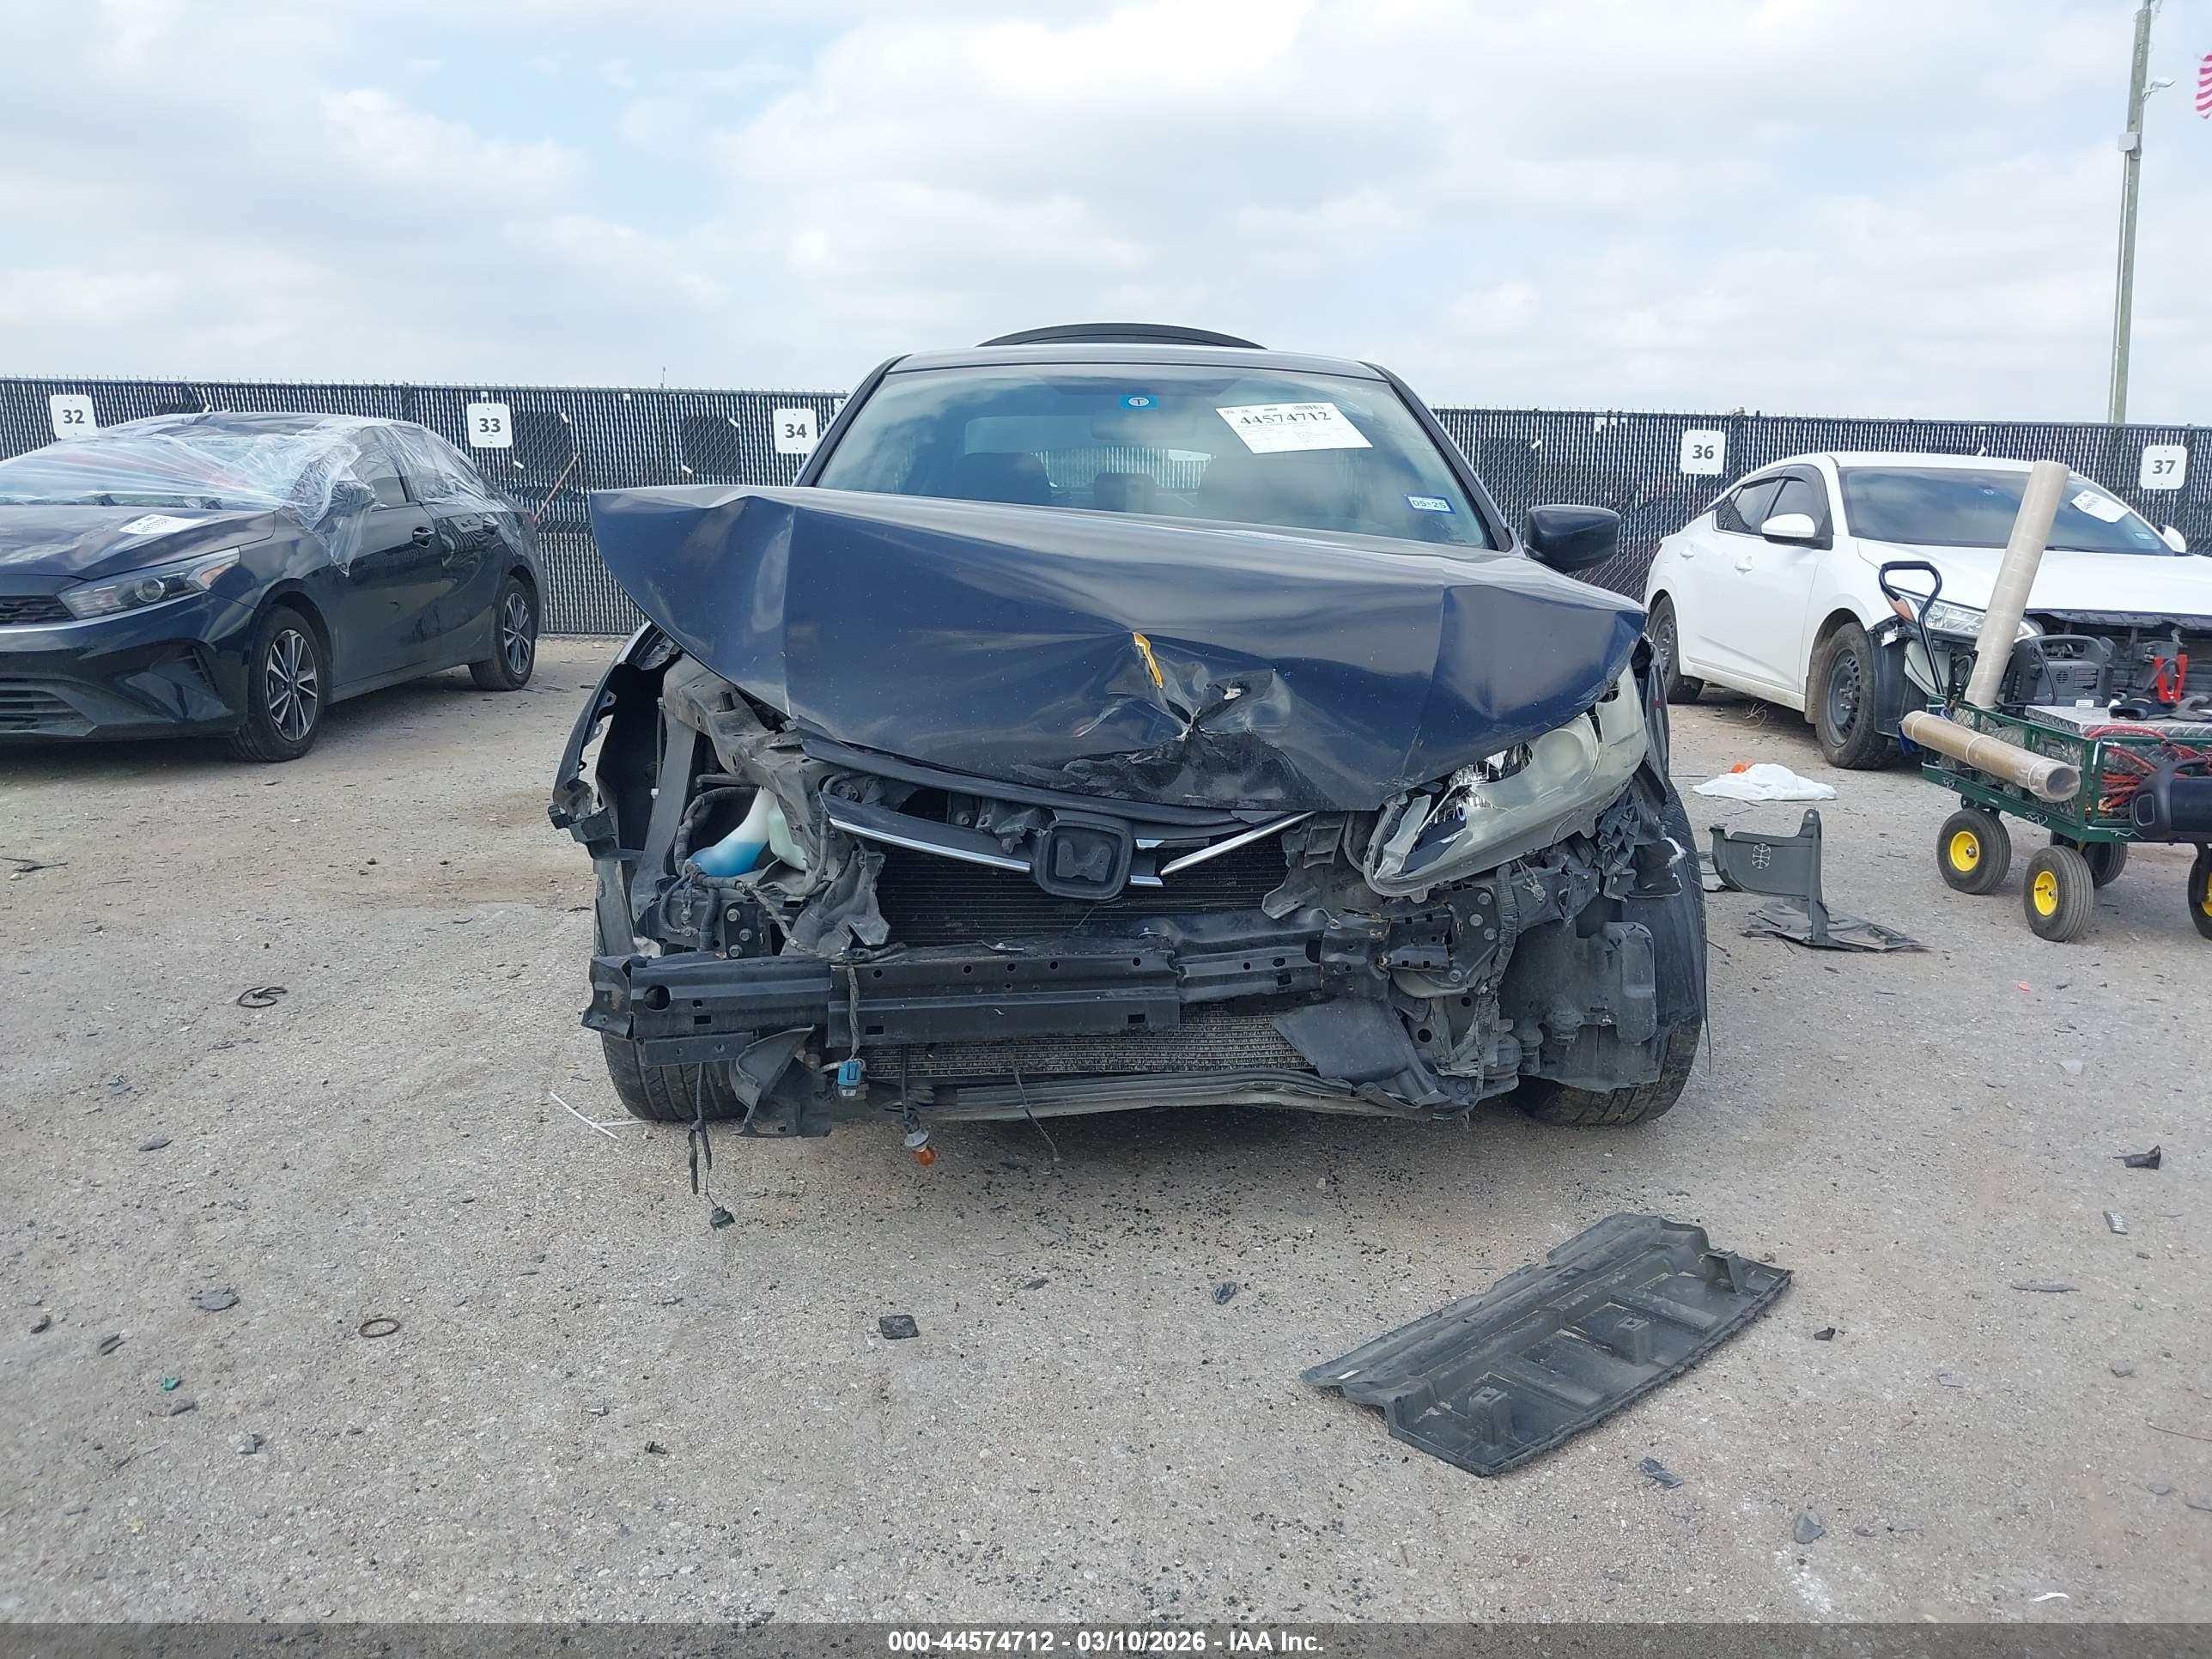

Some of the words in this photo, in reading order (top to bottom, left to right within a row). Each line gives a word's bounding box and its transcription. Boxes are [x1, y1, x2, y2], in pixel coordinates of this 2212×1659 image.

[63, 409, 85, 424] 32
[1239, 411, 1332, 425] 44574712
[479, 417, 501, 433] 33
[785, 423, 807, 439] 34
[1692, 444, 1714, 459] 36
[2153, 459, 2176, 474] 37
